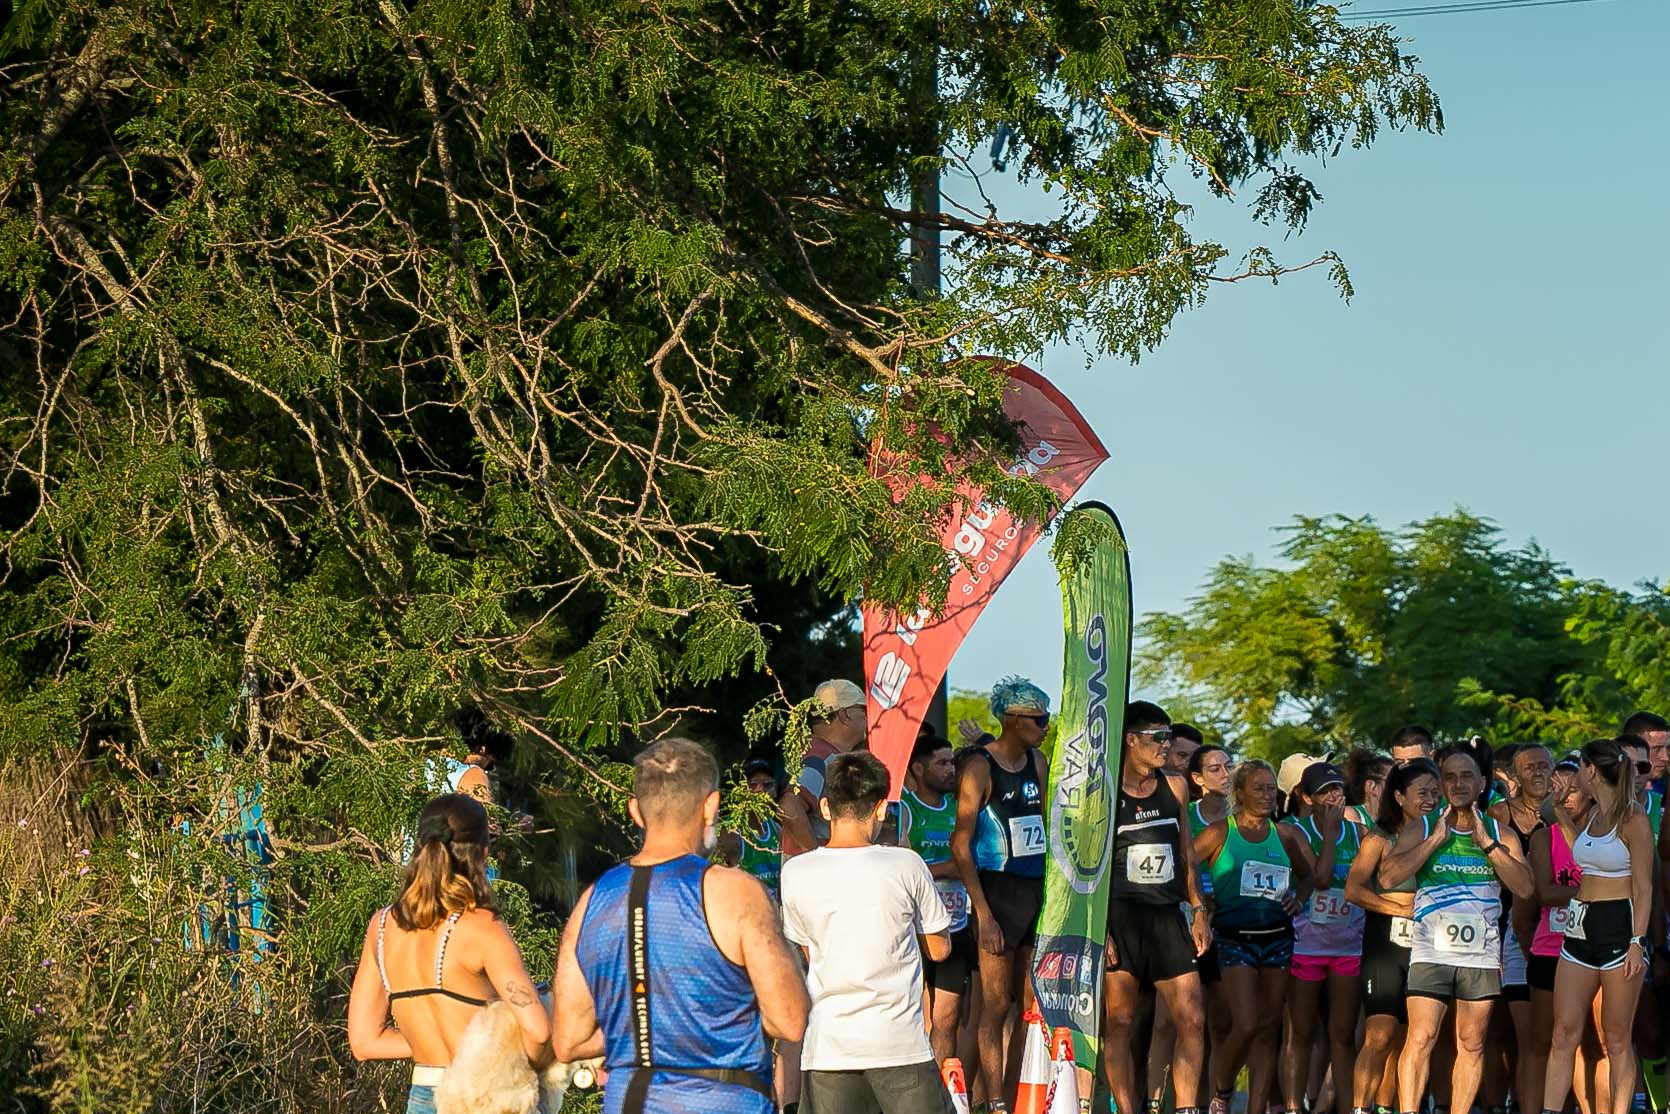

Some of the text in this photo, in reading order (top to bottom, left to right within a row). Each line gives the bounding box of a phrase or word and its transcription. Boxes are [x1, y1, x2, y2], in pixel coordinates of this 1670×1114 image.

[1023, 826, 1044, 846] 72
[1139, 856, 1166, 874] 47
[1254, 873, 1276, 891] 11
[939, 892, 964, 909] 35
[1314, 896, 1350, 916] 516
[1446, 924, 1475, 943] 90
